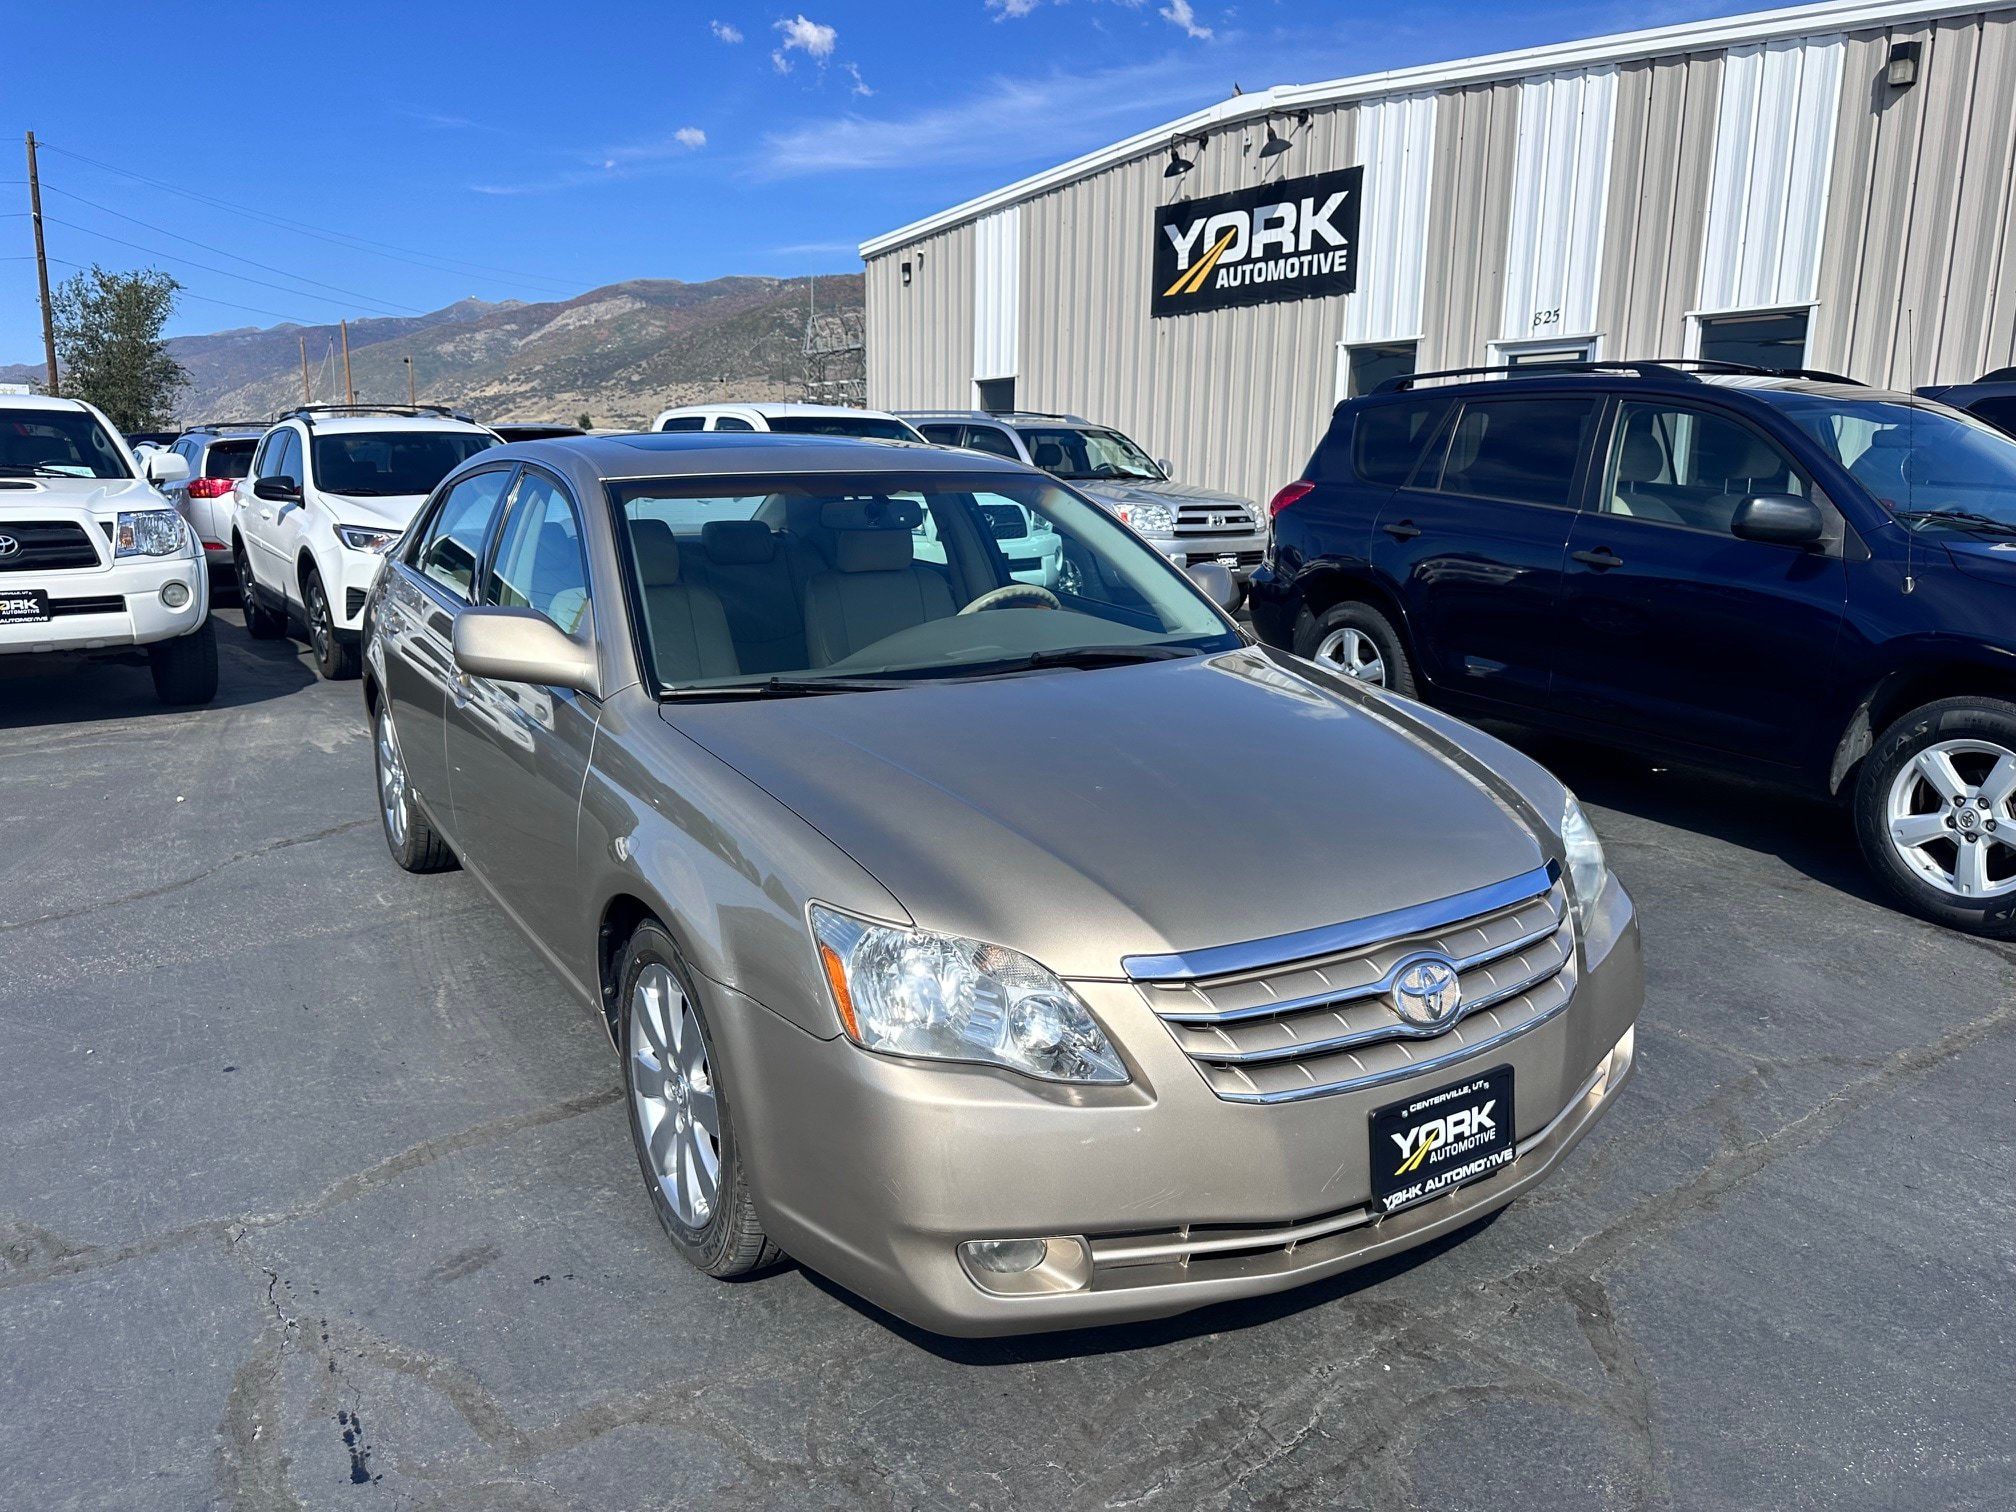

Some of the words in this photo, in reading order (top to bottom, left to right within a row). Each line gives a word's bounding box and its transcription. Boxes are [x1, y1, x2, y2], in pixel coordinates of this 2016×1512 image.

[1163, 190, 1349, 271] YORK
[1215, 249, 1348, 289] AUTOMOTIVE
[1533, 309, 1560, 326] 825
[0, 598, 39, 610] ORK
[1409, 1086, 1471, 1112] CENTERVILLE,
[1472, 1080, 1484, 1090] UT
[1391, 1099, 1496, 1159] YORK
[1429, 1128, 1496, 1164] AUTOMOTIVE
[1382, 1183, 1422, 1211] YORK
[1425, 1147, 1513, 1193] AUTOMOTIVE
